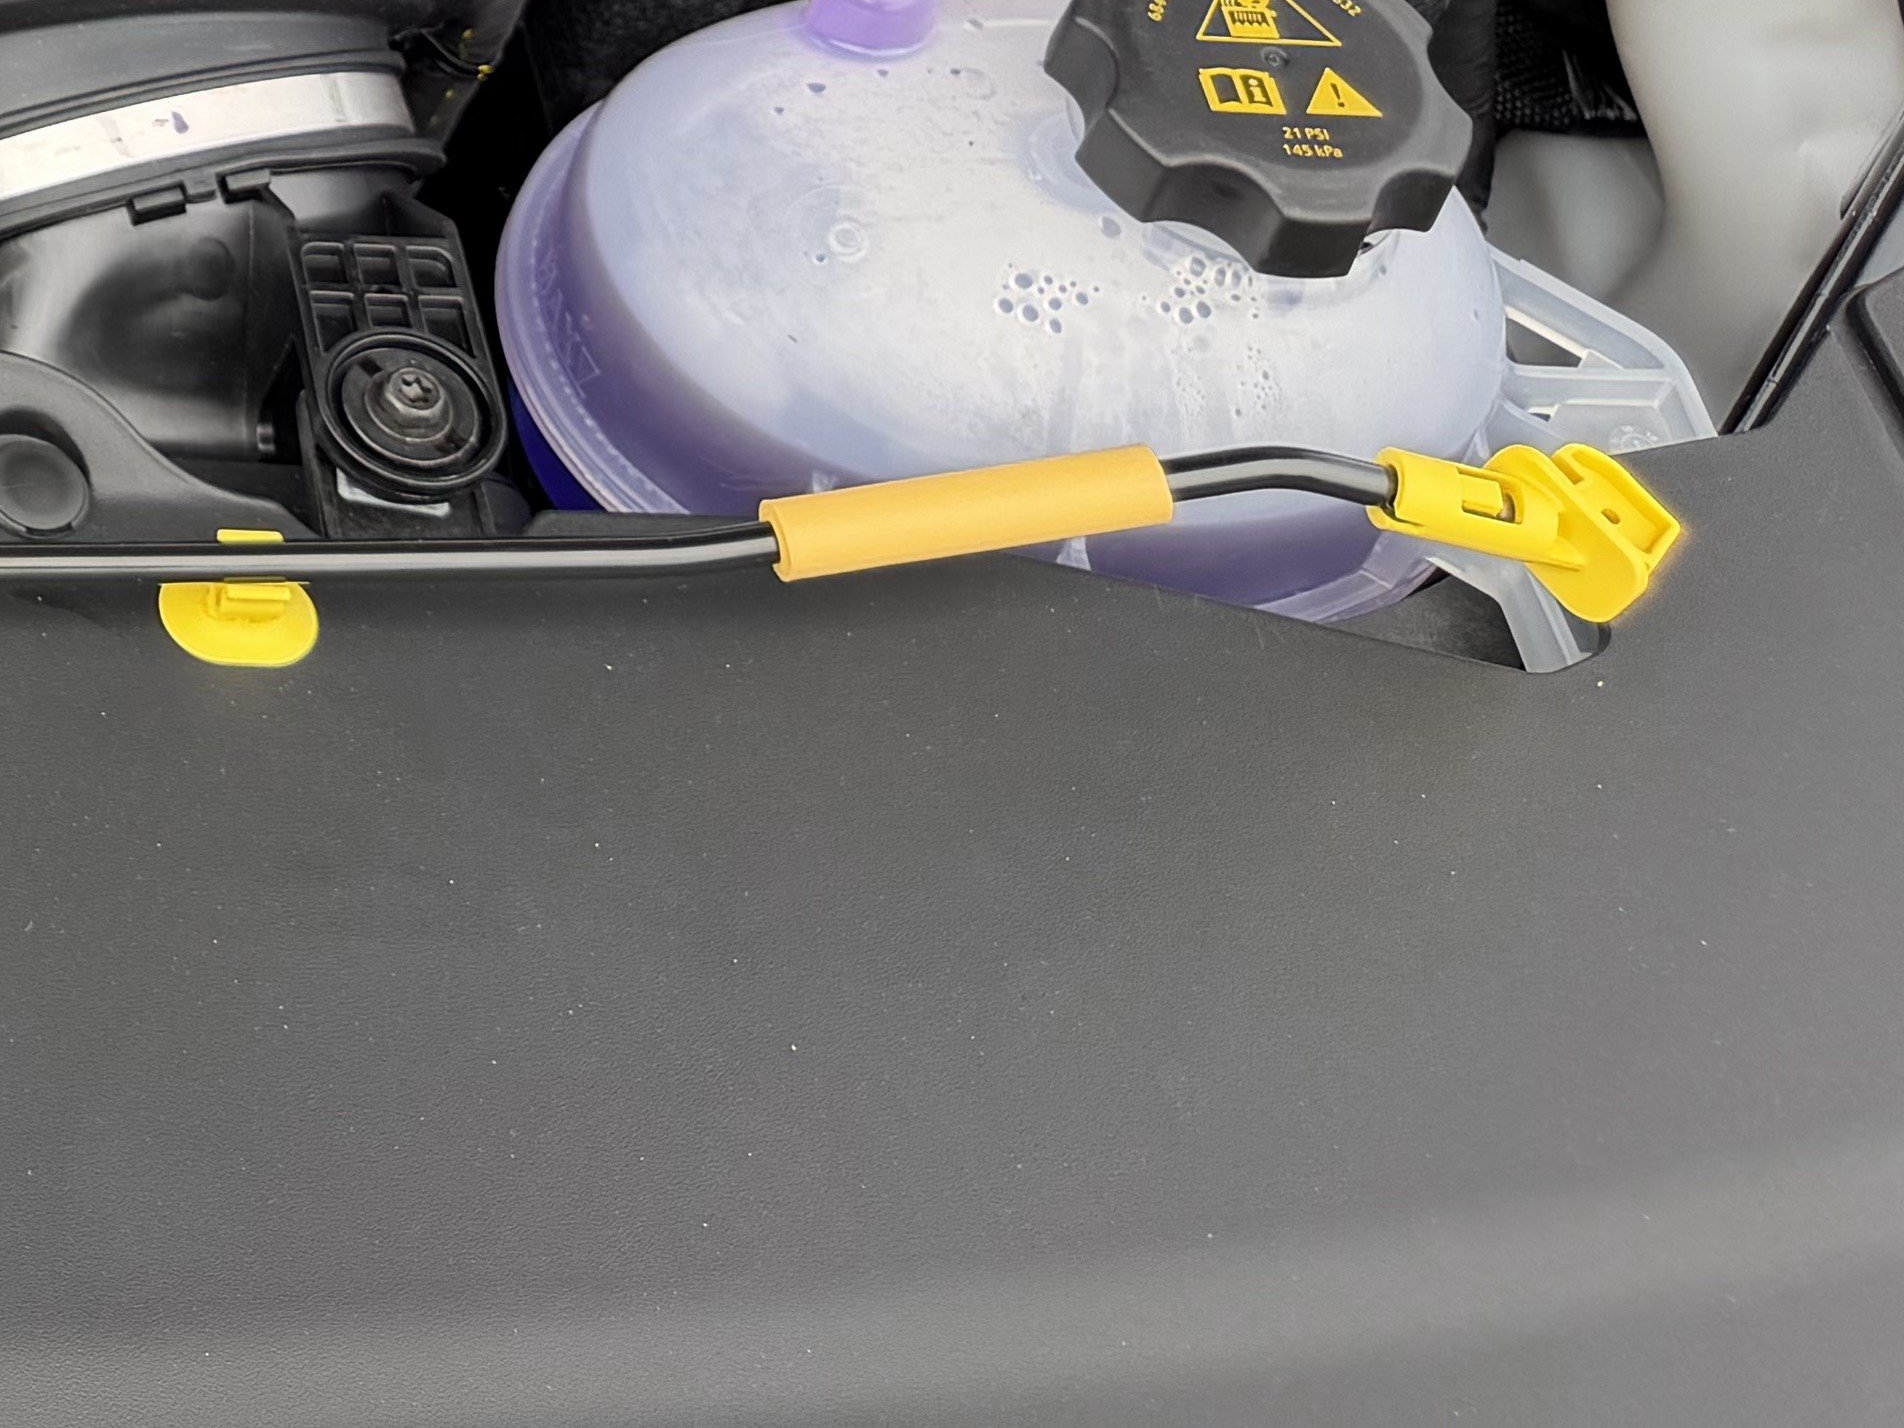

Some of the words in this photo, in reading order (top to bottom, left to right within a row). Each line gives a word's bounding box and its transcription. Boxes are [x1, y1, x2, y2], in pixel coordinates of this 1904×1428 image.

[1282, 126, 1302, 141] 21
[1305, 127, 1330, 142] PSI
[1283, 143, 1313, 158] 145
[1315, 144, 1344, 159] kPa
